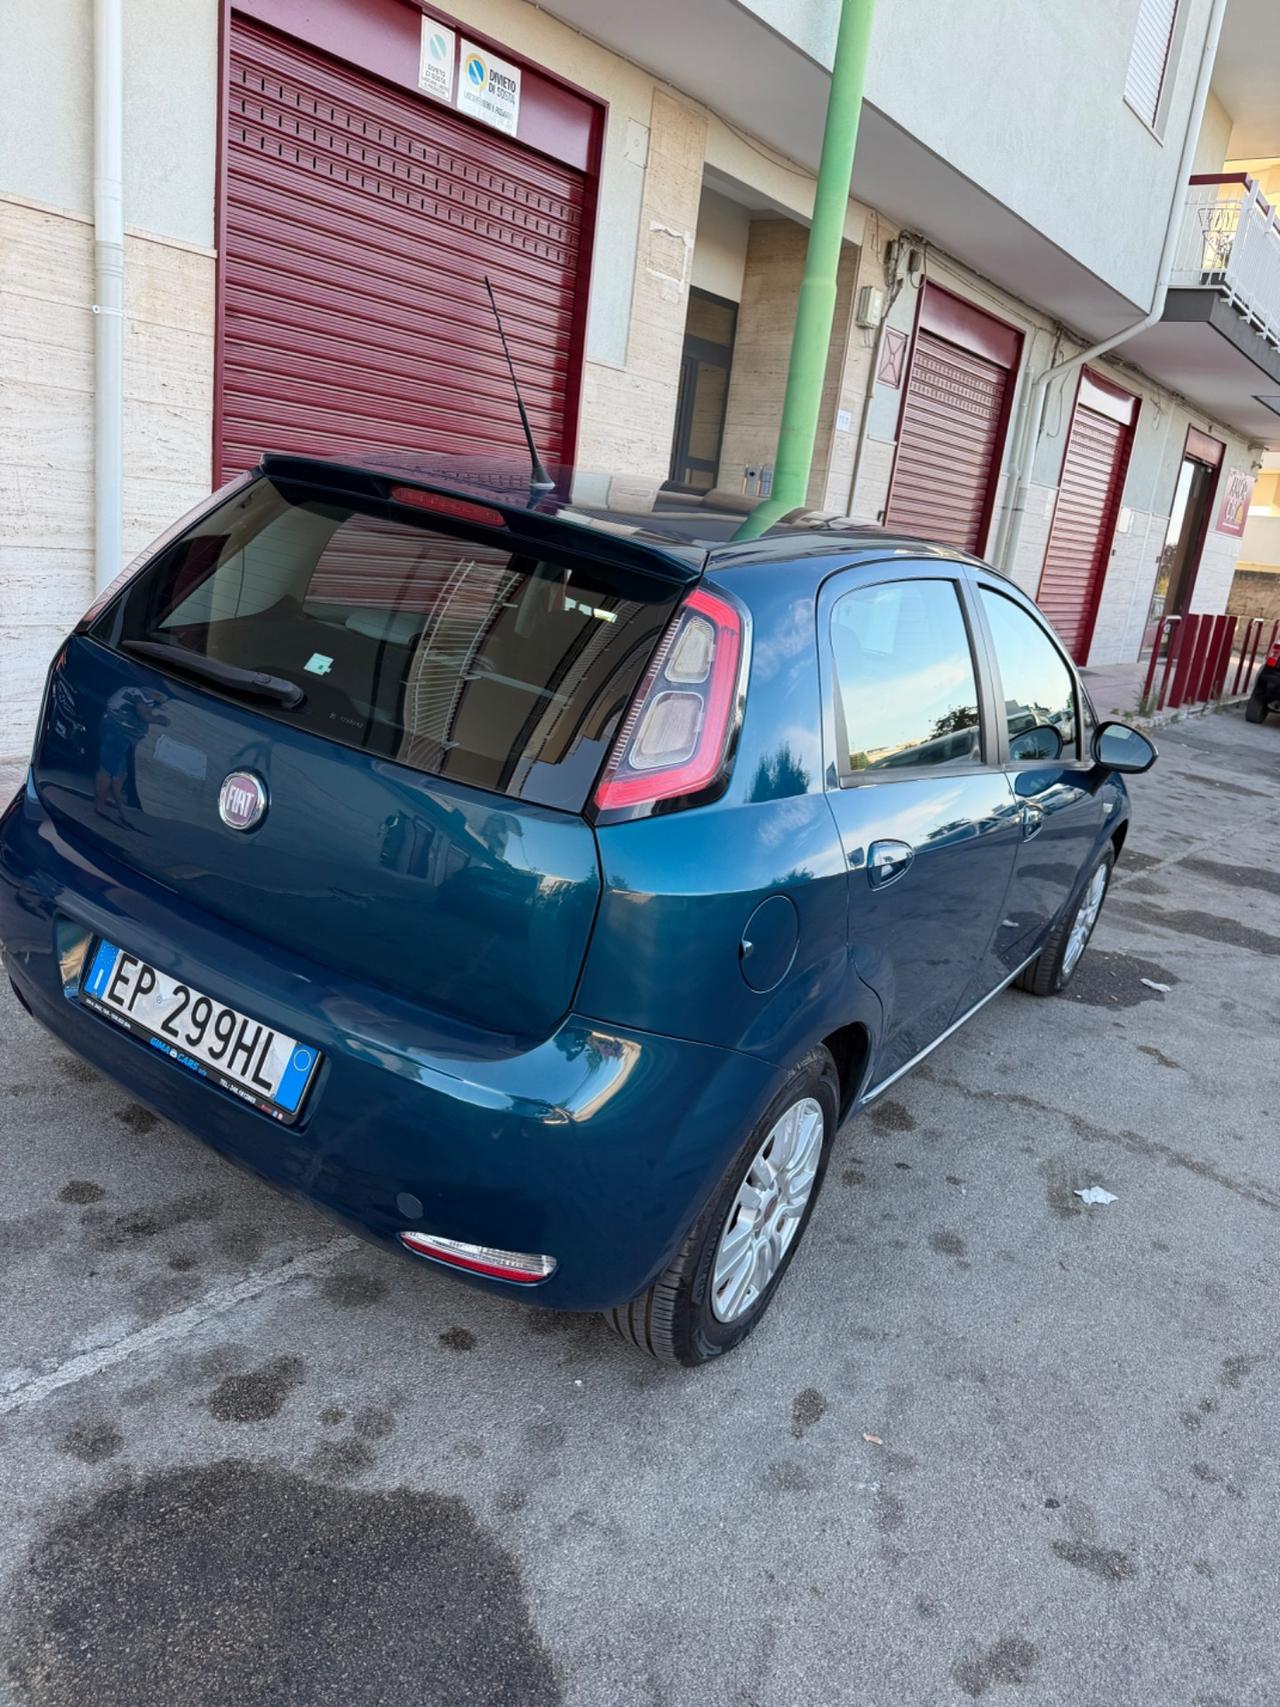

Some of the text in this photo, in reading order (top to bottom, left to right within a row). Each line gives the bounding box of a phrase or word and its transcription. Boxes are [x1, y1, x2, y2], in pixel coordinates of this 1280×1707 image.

[489, 69, 516, 93] DIVIETO
[489, 83, 496, 94] DI
[225, 784, 255, 817] FIAT
[107, 954, 274, 1091] EP 299HL
